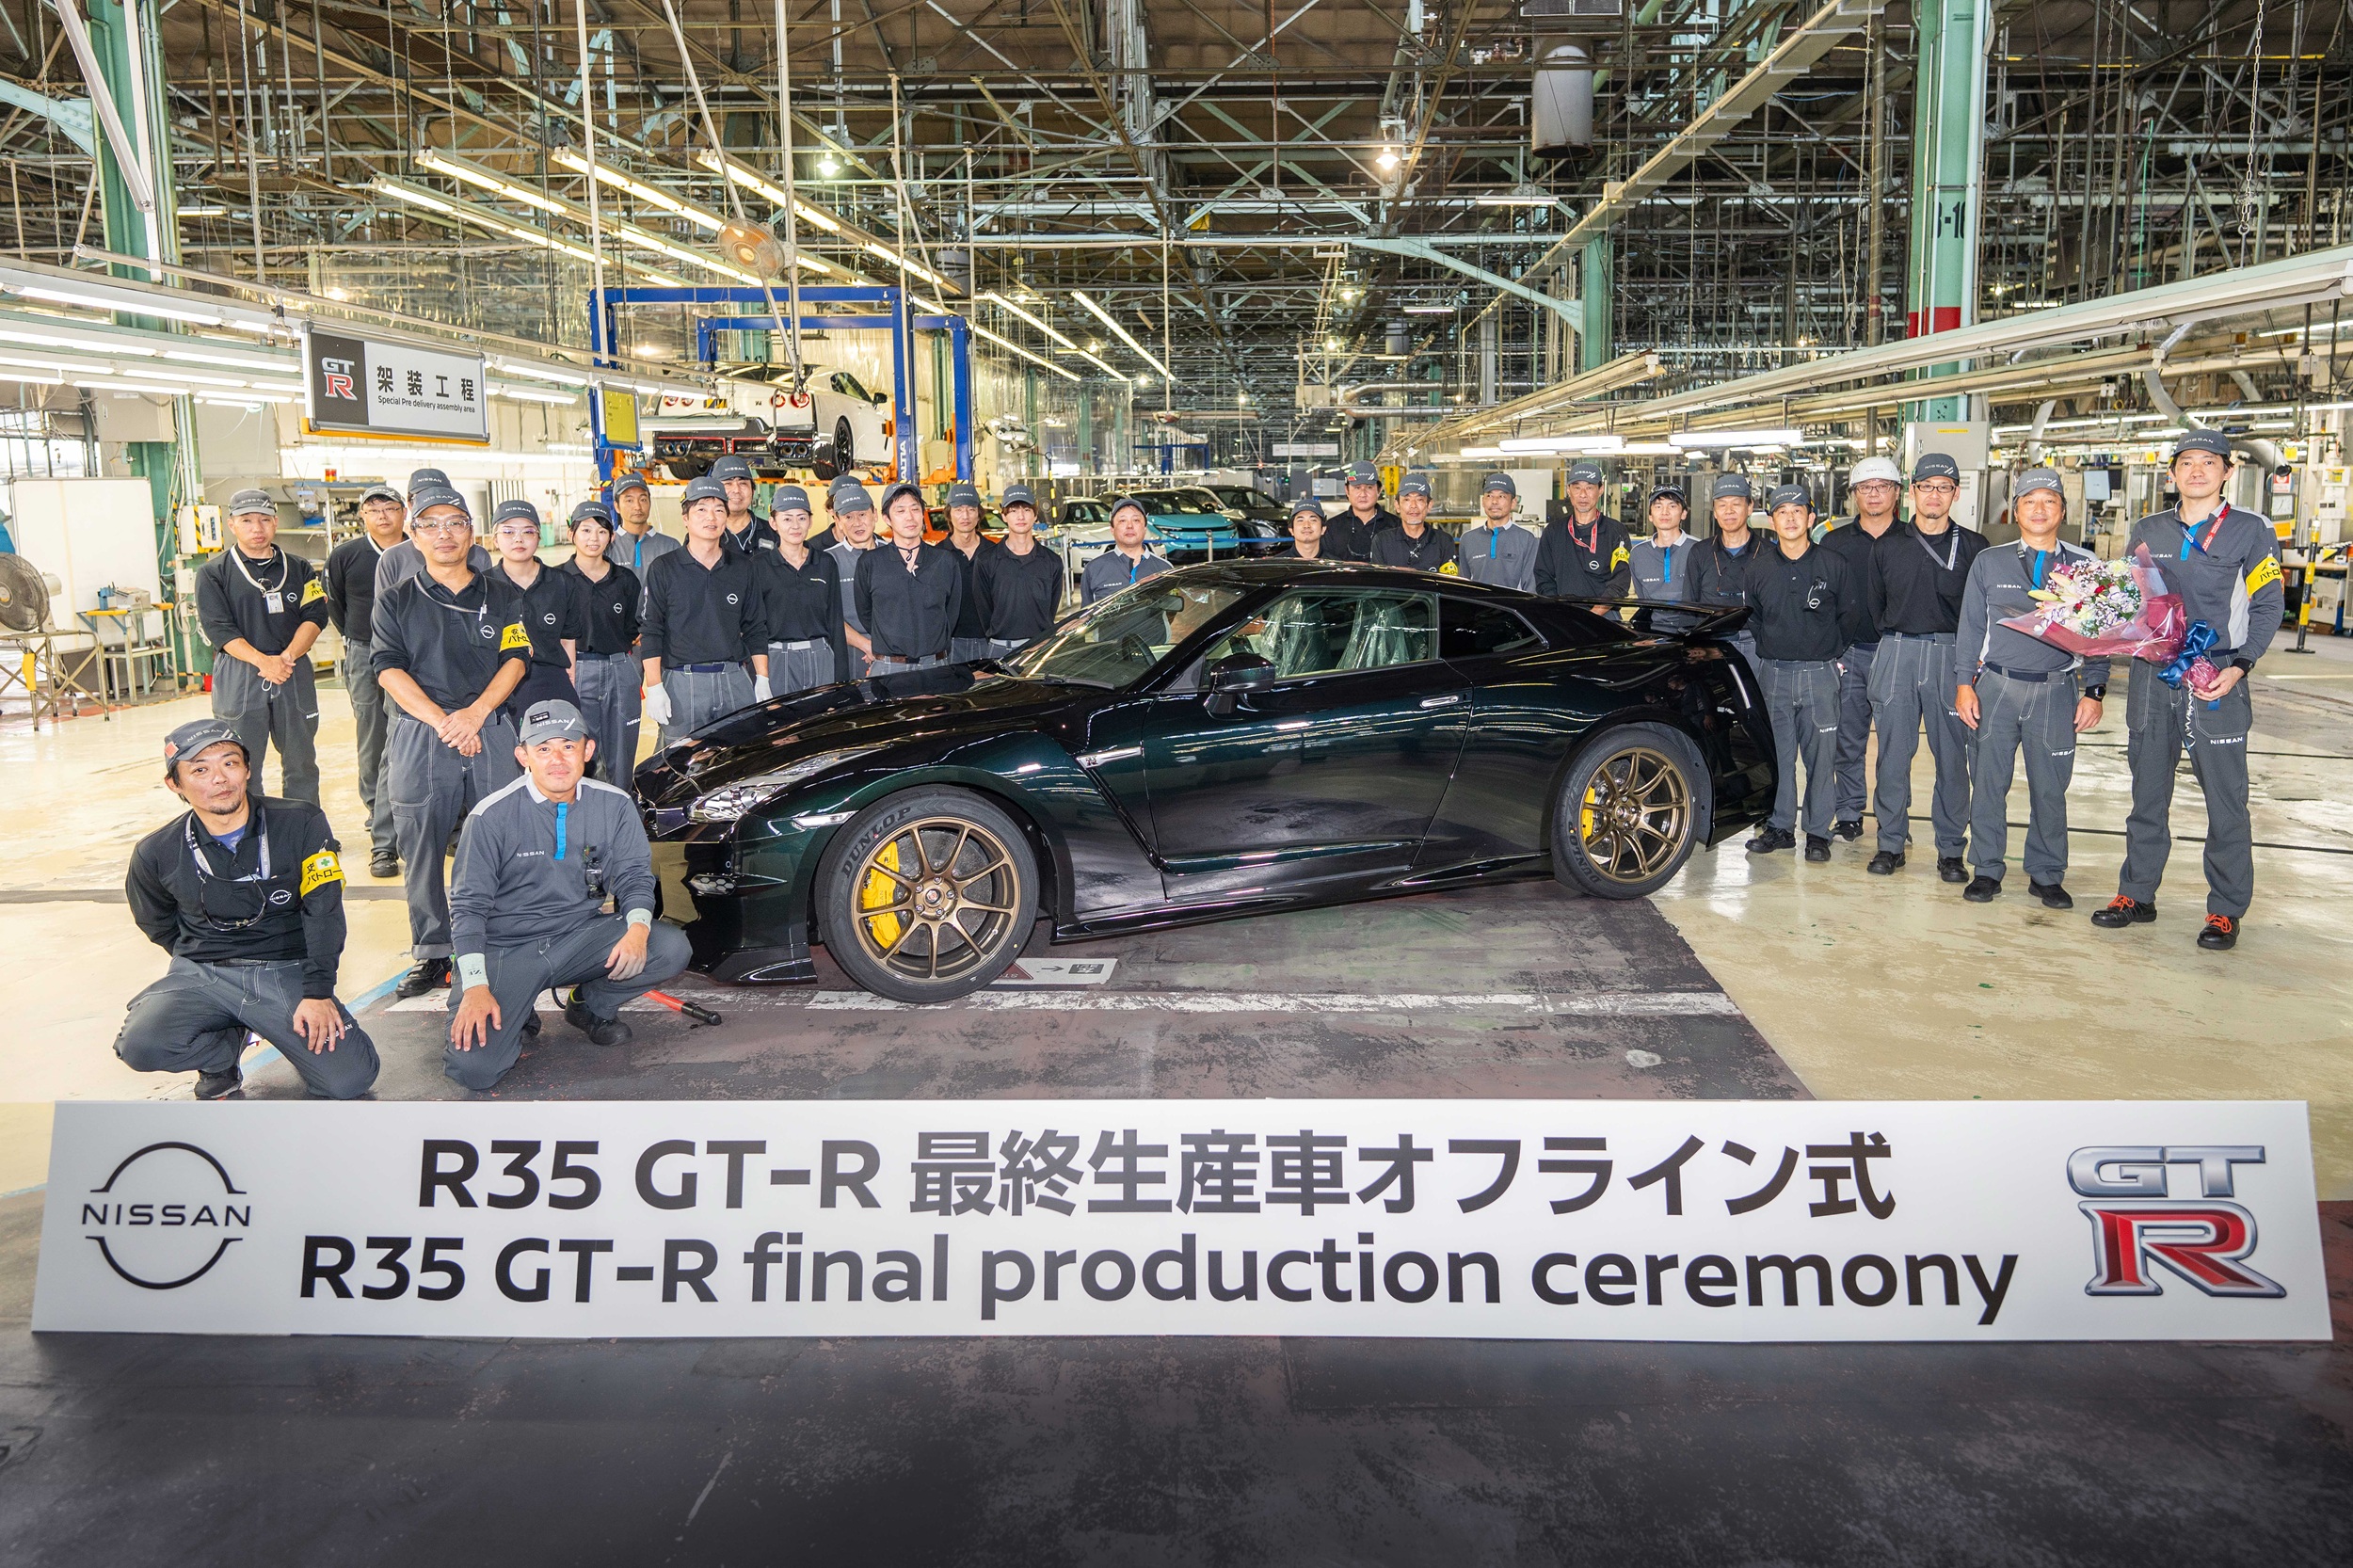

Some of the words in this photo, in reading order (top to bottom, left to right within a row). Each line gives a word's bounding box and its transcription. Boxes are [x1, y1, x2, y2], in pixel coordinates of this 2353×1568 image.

[321, 357, 355, 375] GT
[324, 372, 359, 401] R
[376, 365, 475, 402] 架装工程
[378, 395, 401, 407] Special
[401, 397, 412, 407] Pre
[412, 400, 436, 410] delivery
[436, 402, 463, 413] assembly
[423, 494, 454, 503] NISSAN
[841, 496, 861, 504] NISSAN
[1775, 491, 1798, 500] NISSAN
[536, 718, 569, 728] NISSAN
[626, 717, 641, 727] NISSA
[186, 728, 223, 743] NISSAN
[840, 806, 911, 879] DUNLOP
[1567, 821, 1600, 884] DUNLOP
[269, 892, 292, 902] NISSAN
[419, 1140, 600, 1209] R35
[635, 1140, 881, 1209] GT-R
[910, 1130, 1896, 1219] 最終生産車オフライン式
[2066, 1144, 2266, 1198] GT
[82, 1204, 250, 1226] NISSAN
[2077, 1200, 2288, 1299] R
[300, 1236, 465, 1301] R35
[495, 1238, 718, 1303] GT-R
[744, 1232, 948, 1302] final
[982, 1233, 1500, 1320] production
[1532, 1253, 2018, 1325] ceremony
